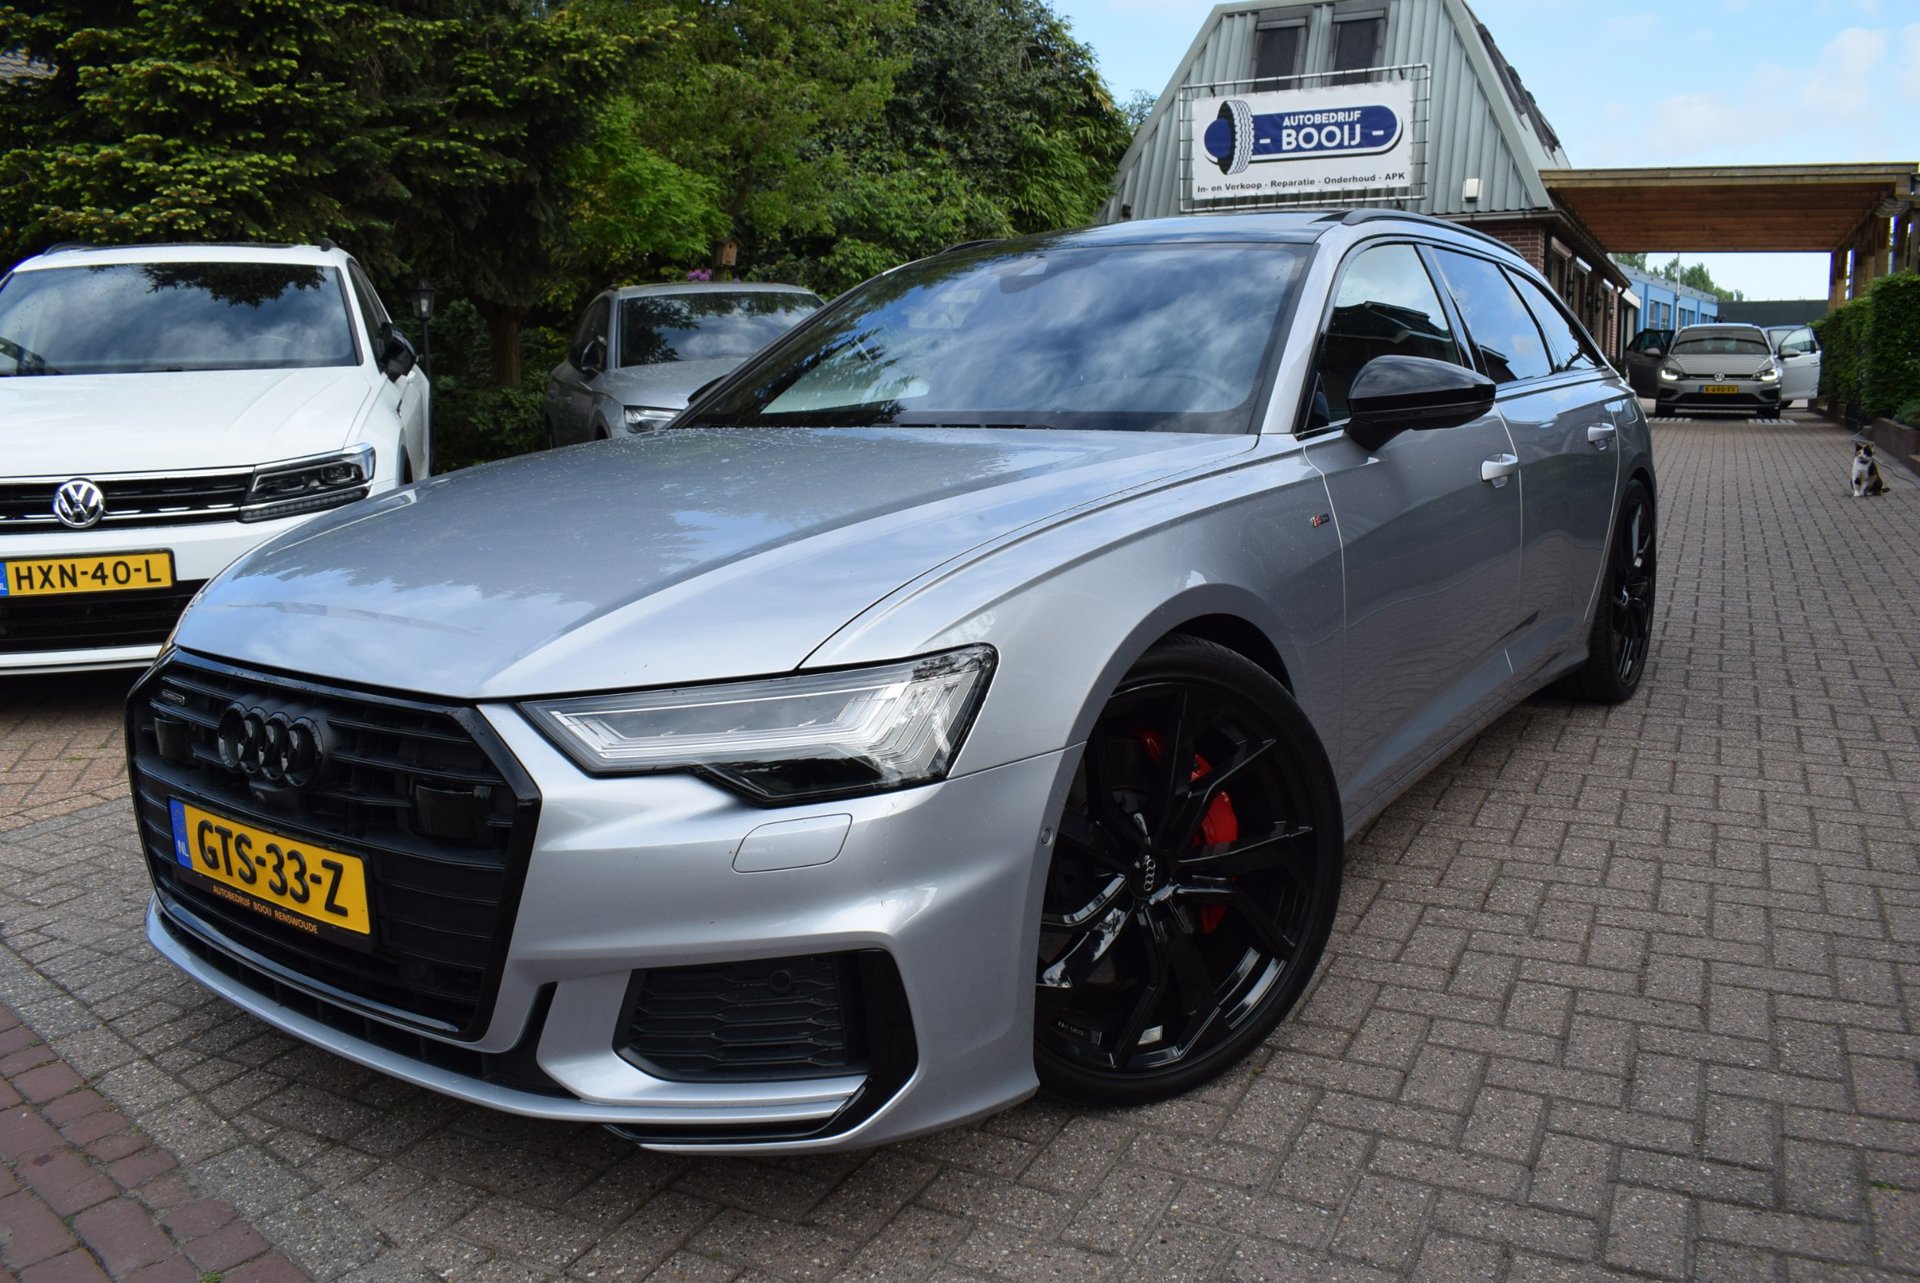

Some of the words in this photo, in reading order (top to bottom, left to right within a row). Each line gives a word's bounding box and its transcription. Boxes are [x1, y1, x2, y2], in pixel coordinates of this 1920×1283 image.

[1282, 110, 1362, 126] AUTOBEDRIJF
[1281, 124, 1361, 150] BOOIJ
[1197, 184, 1210, 193] In-
[1225, 182, 1262, 192] Verkoop
[1270, 178, 1315, 188] Reparatie
[1324, 174, 1376, 185] Onderhoud
[1384, 172, 1406, 181] APK
[14, 559, 162, 591] HXN-40-L
[177, 839, 189, 857] NL
[197, 819, 349, 918] GTS-33-Z
[213, 885, 252, 907] AUTOBEDRIJF
[274, 911, 319, 934] RENSWOUDE
